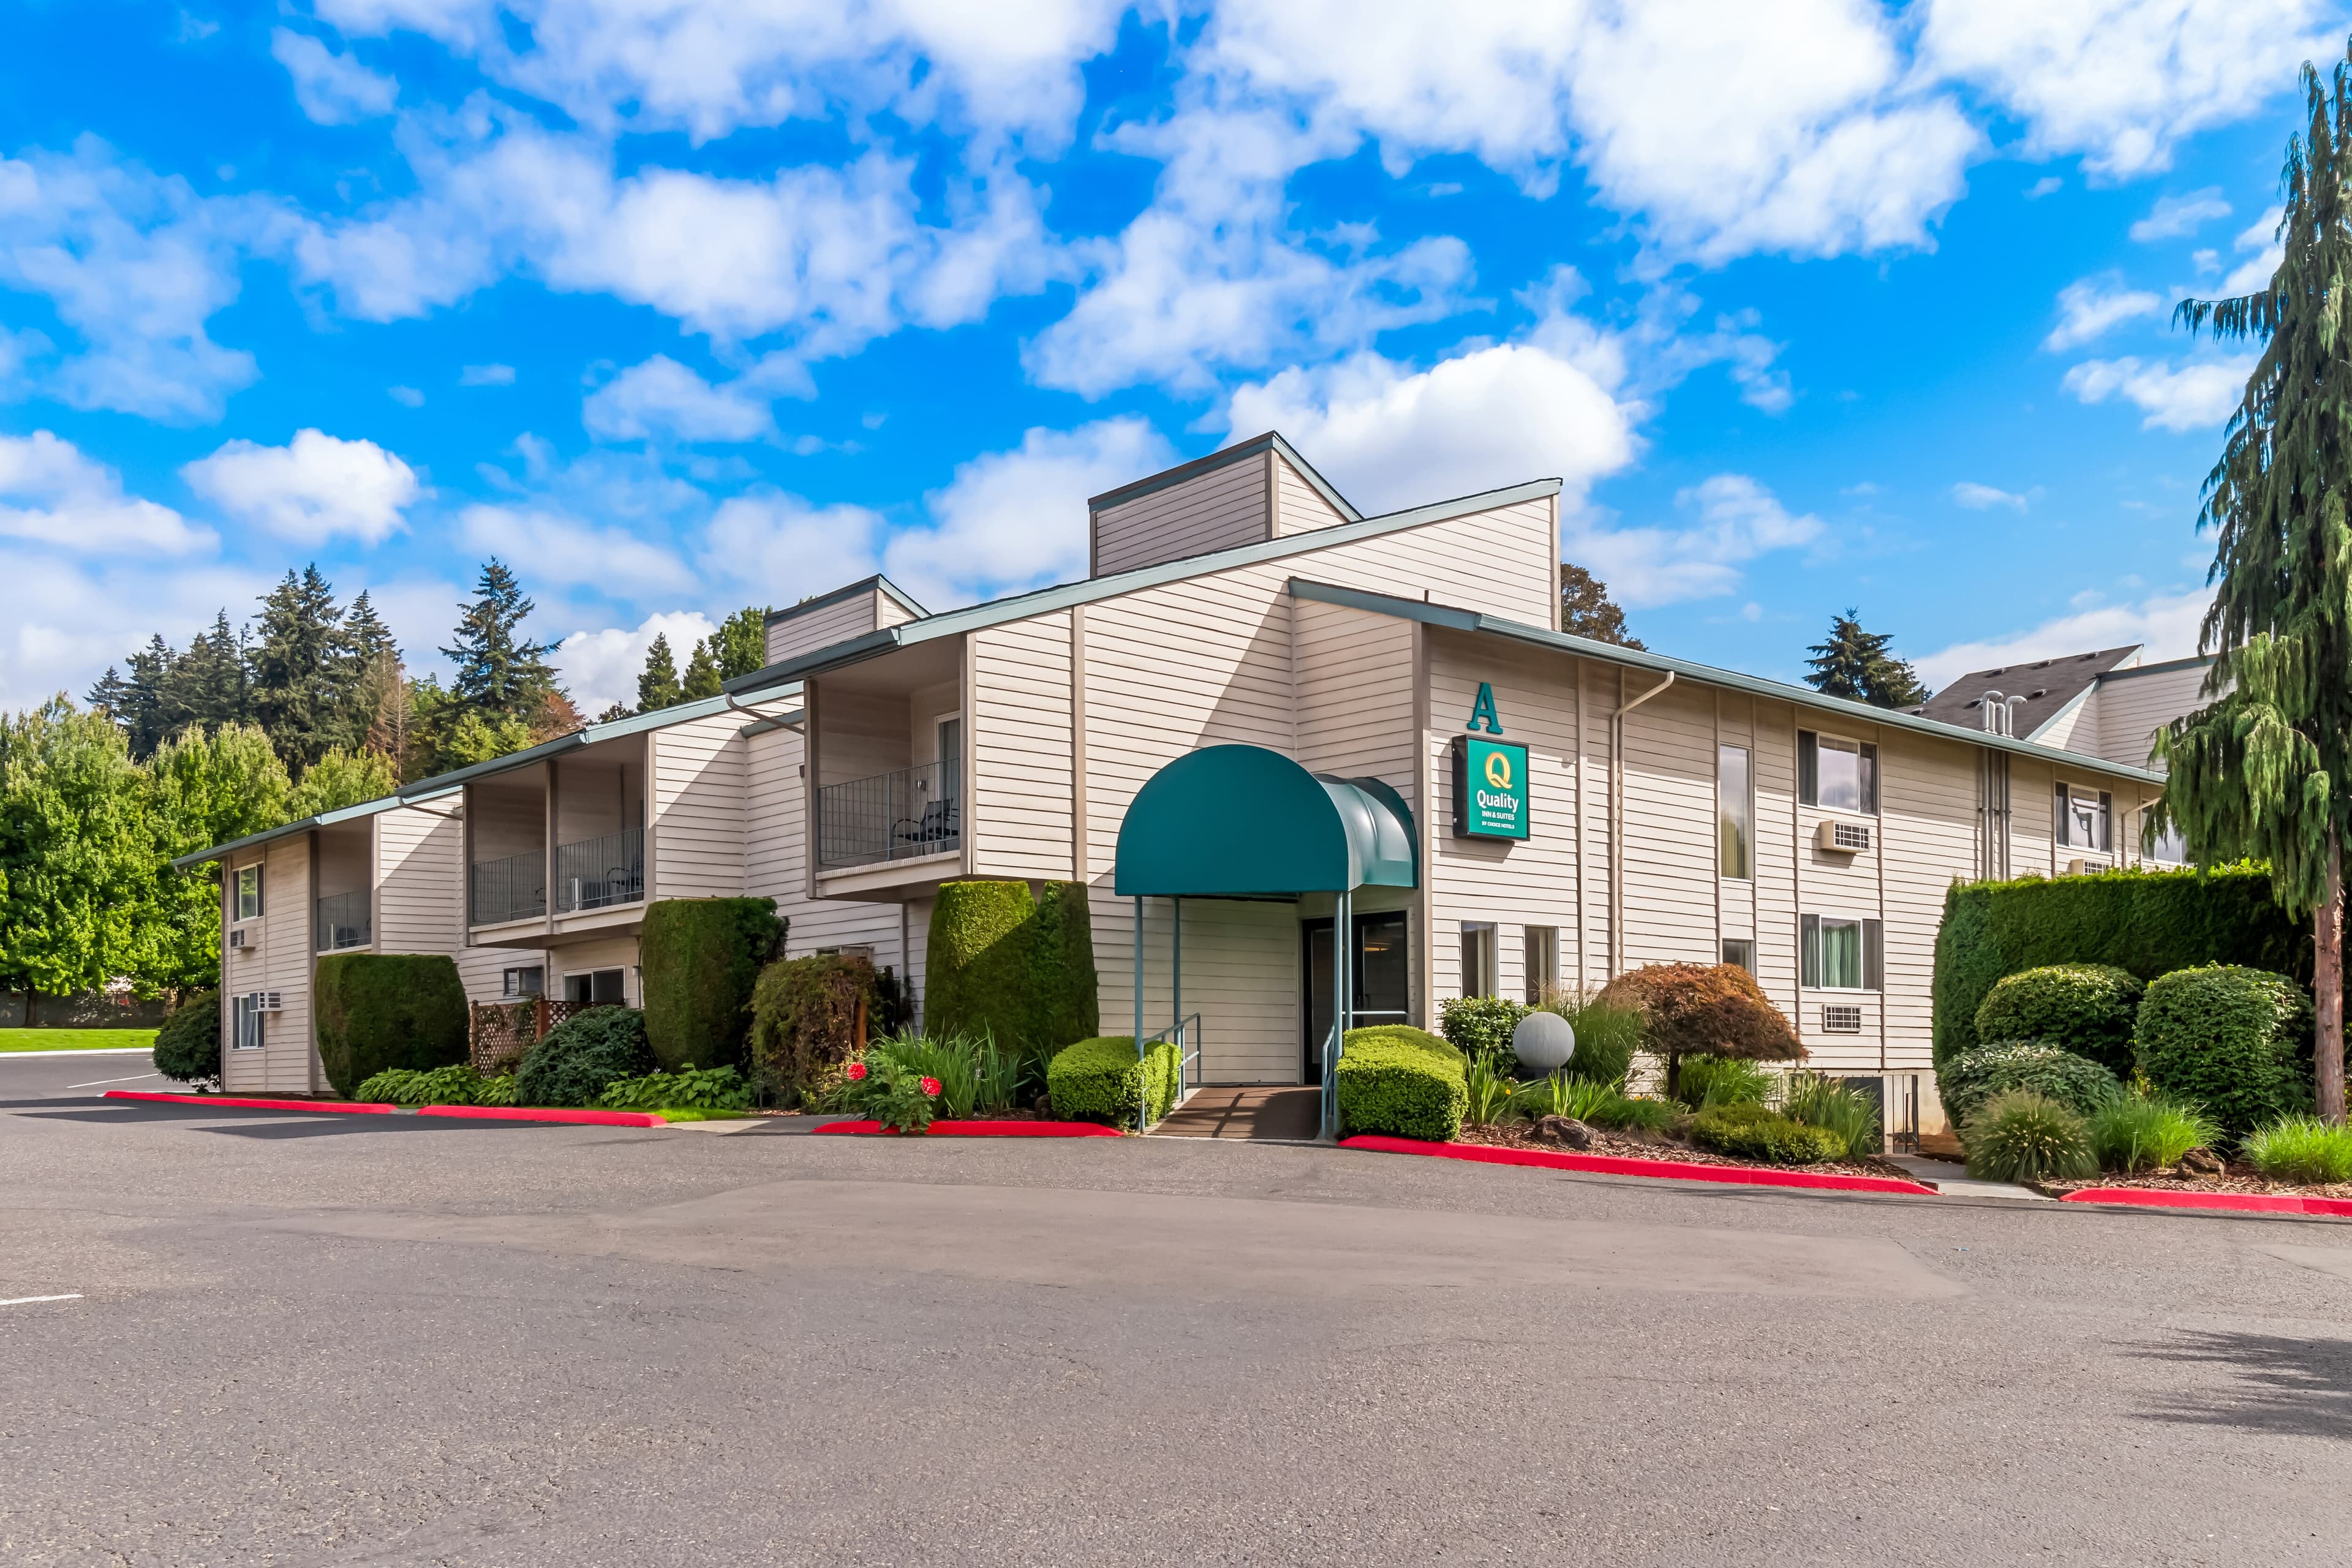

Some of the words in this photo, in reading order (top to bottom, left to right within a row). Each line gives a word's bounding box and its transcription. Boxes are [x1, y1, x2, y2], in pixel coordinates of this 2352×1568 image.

[1466, 682, 1503, 735] A
[1485, 752, 1513, 789] Q
[1477, 790, 1519, 813] Quality
[1496, 812, 1515, 821] SUITES
